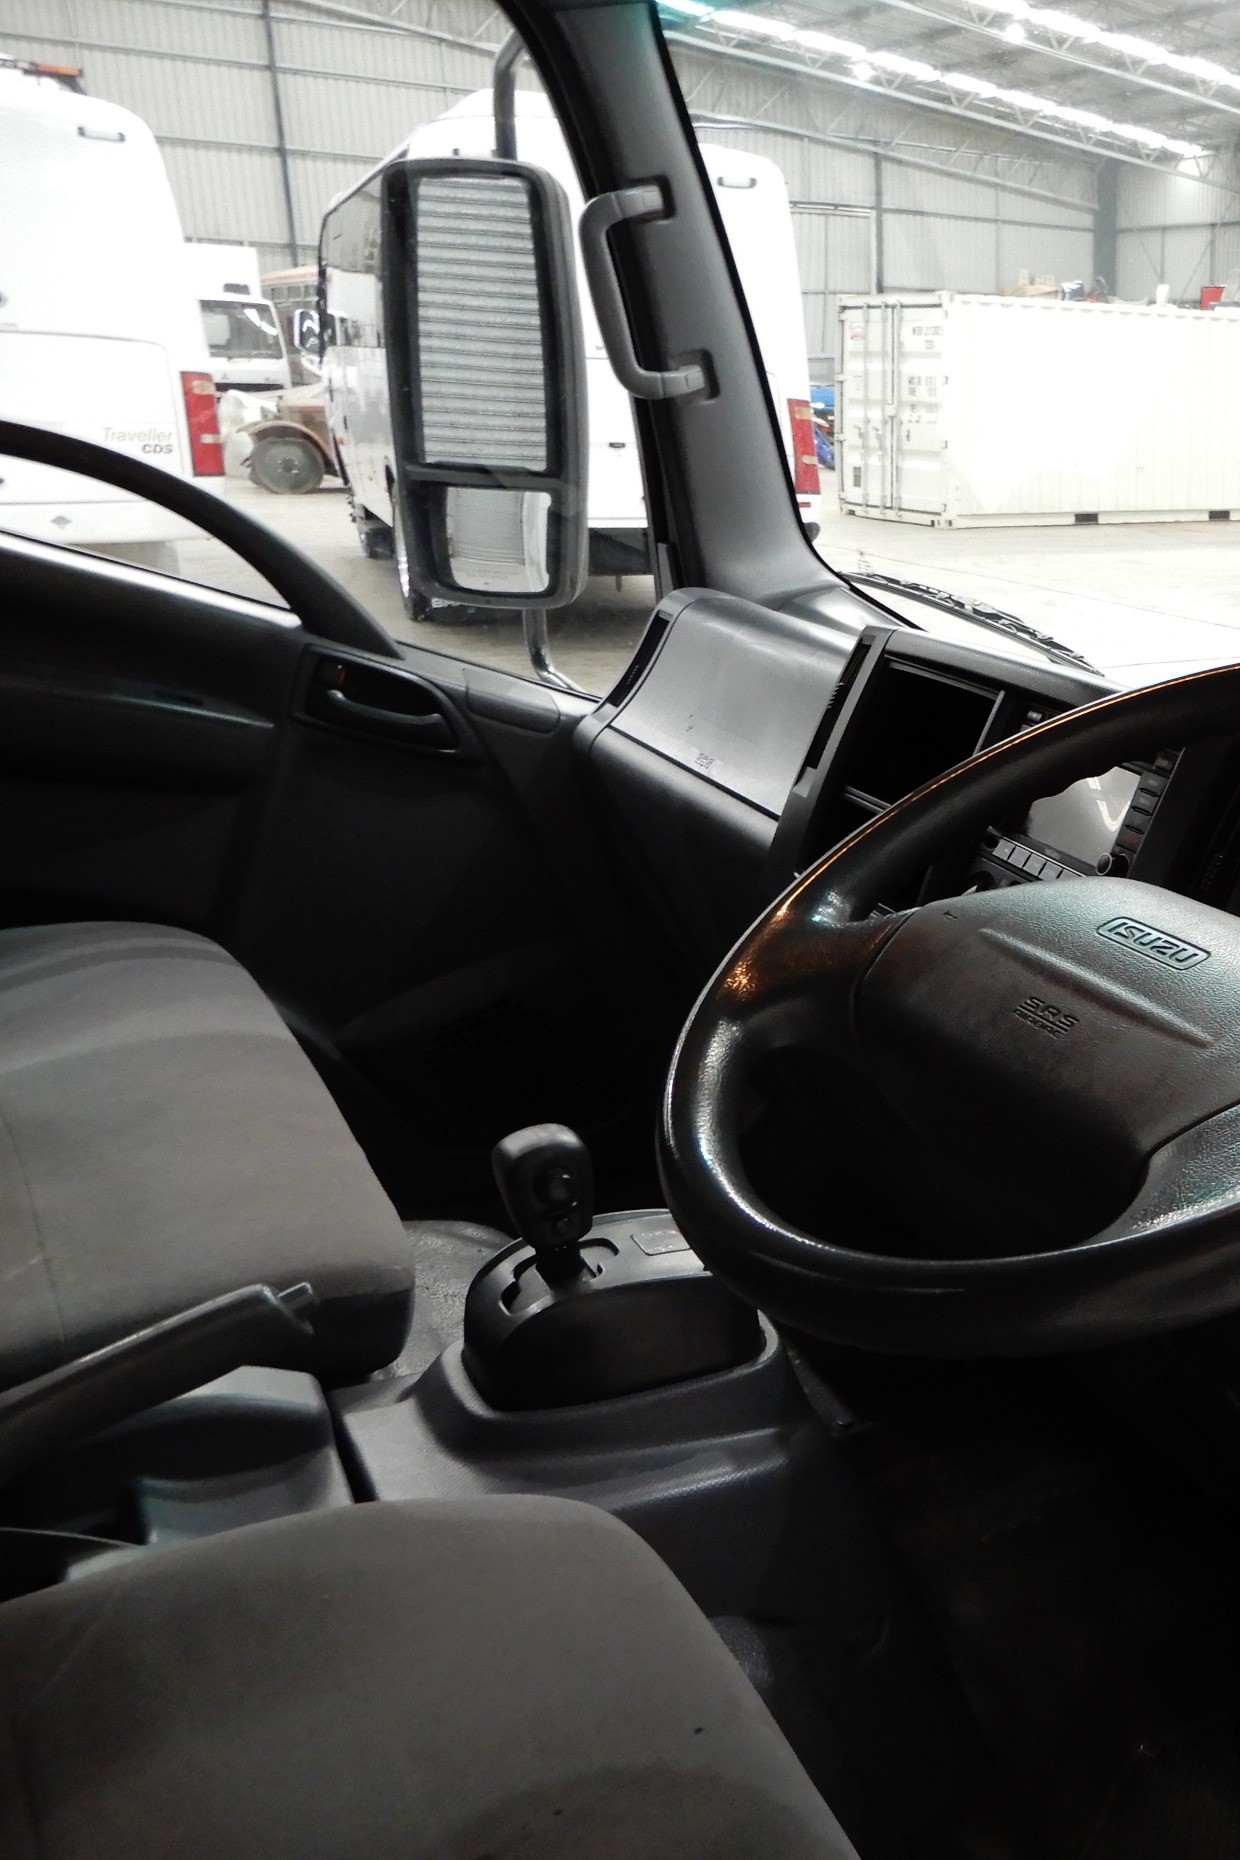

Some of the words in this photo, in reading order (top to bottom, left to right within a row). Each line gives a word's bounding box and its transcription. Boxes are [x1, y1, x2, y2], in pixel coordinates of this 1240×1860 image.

[102, 426, 174, 442] Traveller
[142, 444, 174, 454] CDS
[1106, 921, 1199, 964] ISUZU
[1020, 996, 1080, 1030] SRS
